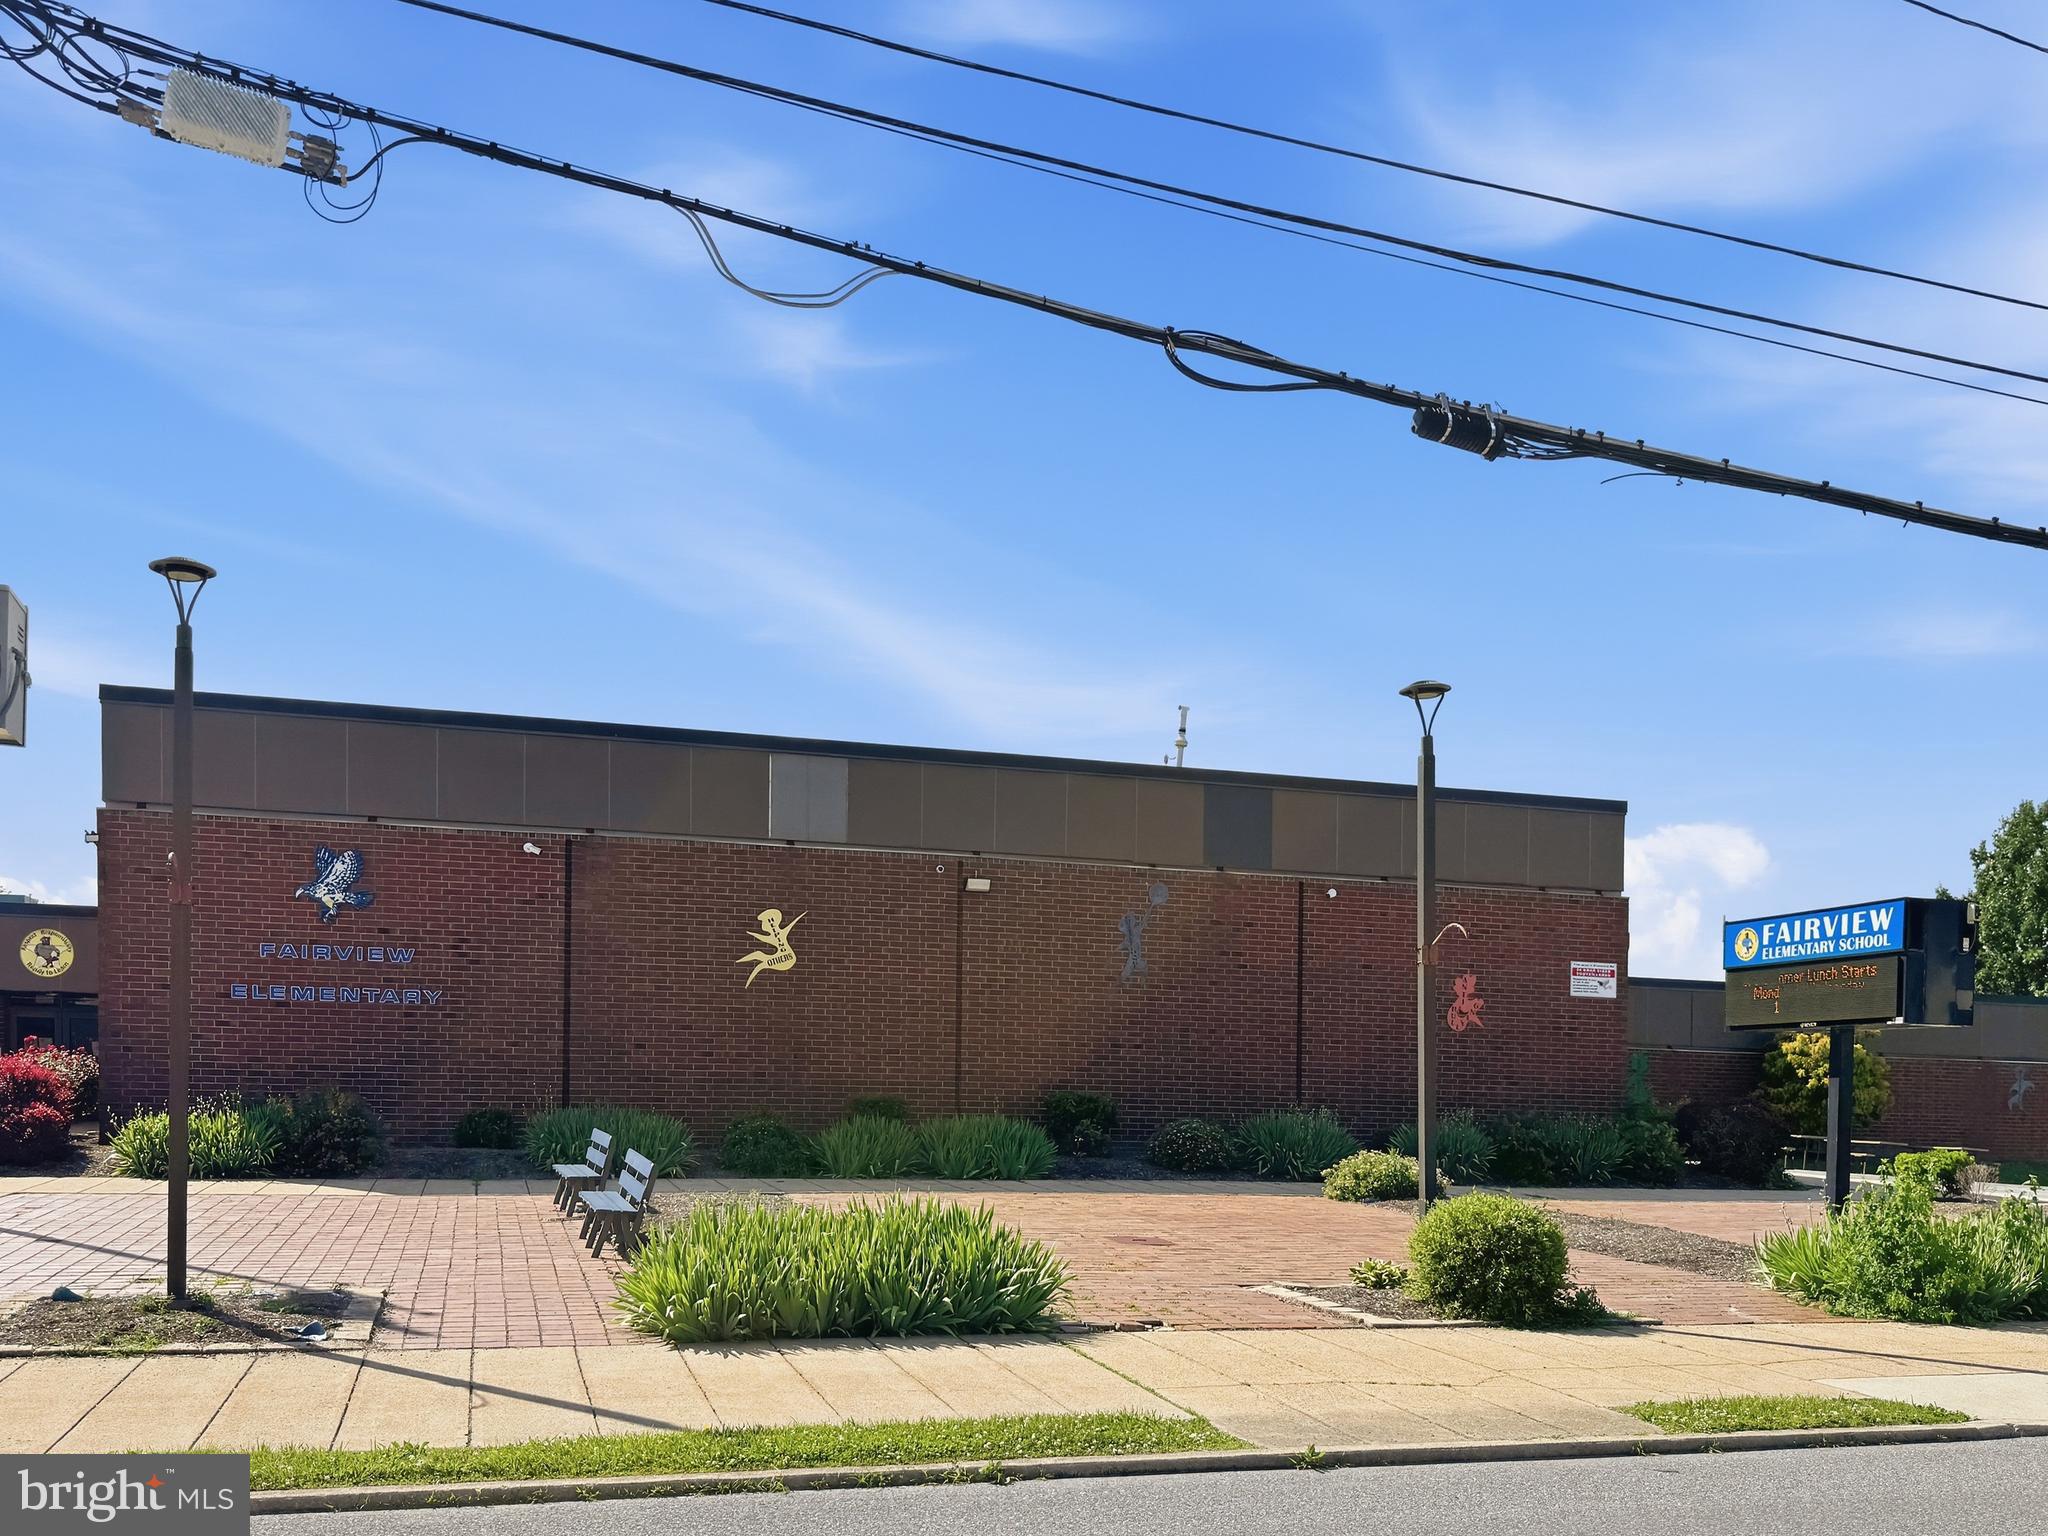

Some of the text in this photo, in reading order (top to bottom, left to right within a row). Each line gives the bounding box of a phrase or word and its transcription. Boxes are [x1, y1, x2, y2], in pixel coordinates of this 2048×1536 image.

[1762, 907, 1894, 945] FAIRVIEW
[259, 942, 415, 963] FAIRVIEW
[1762, 940, 1836, 960] ELEMENTARY
[1839, 933, 1892, 951] SCHOOL
[1807, 967, 1838, 982] Lunch
[1841, 964, 1877, 979] Starts
[230, 983, 443, 1005] ELEMENTARY
